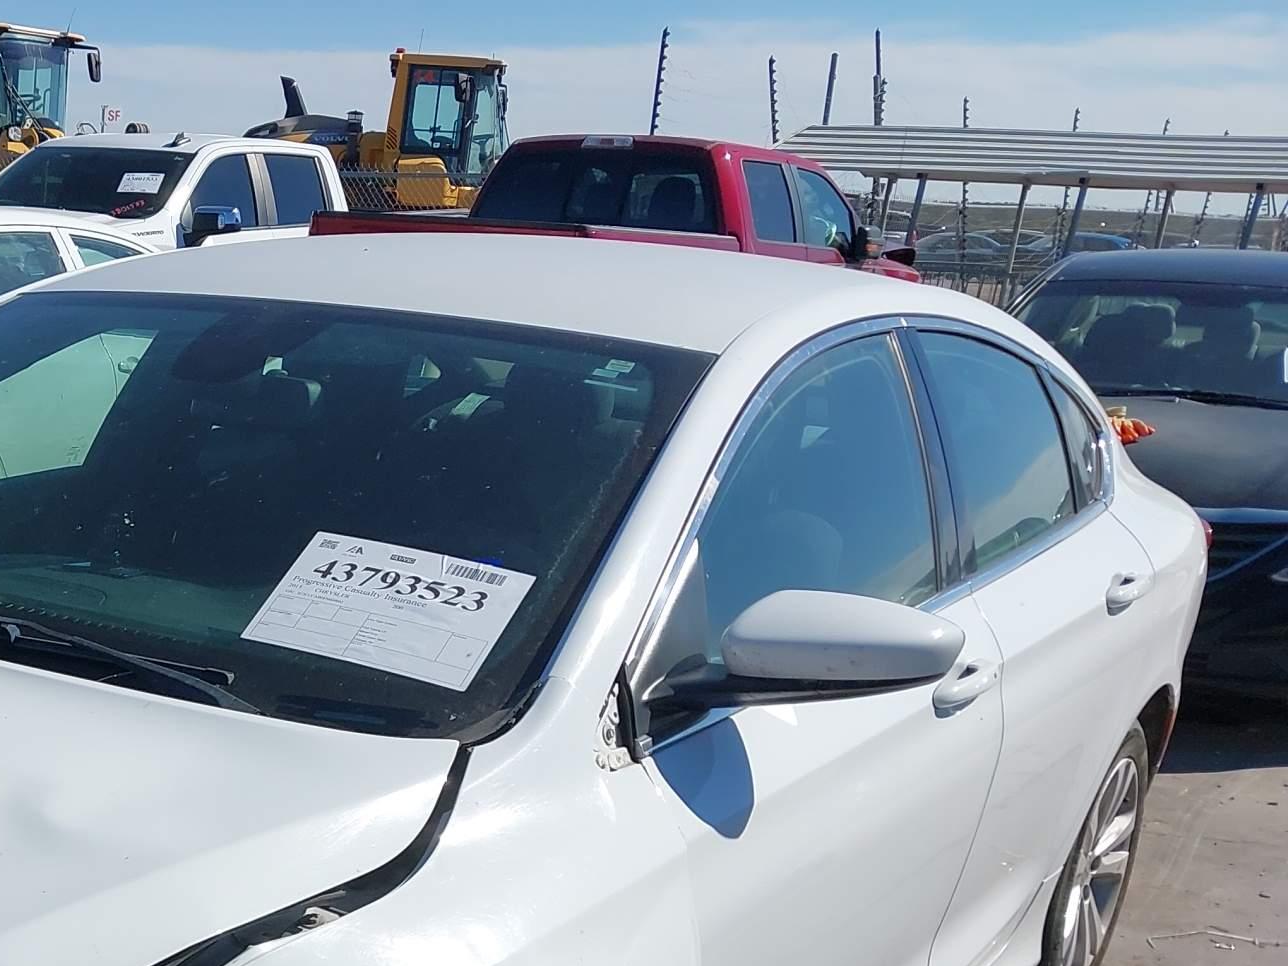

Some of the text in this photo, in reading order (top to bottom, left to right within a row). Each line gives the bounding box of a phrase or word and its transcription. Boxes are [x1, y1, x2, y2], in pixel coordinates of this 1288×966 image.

[292, 575, 343, 590] Progressive
[344, 585, 382, 599] Casualty
[384, 593, 428, 608] Insurance
[312, 559, 490, 612] 43793523
